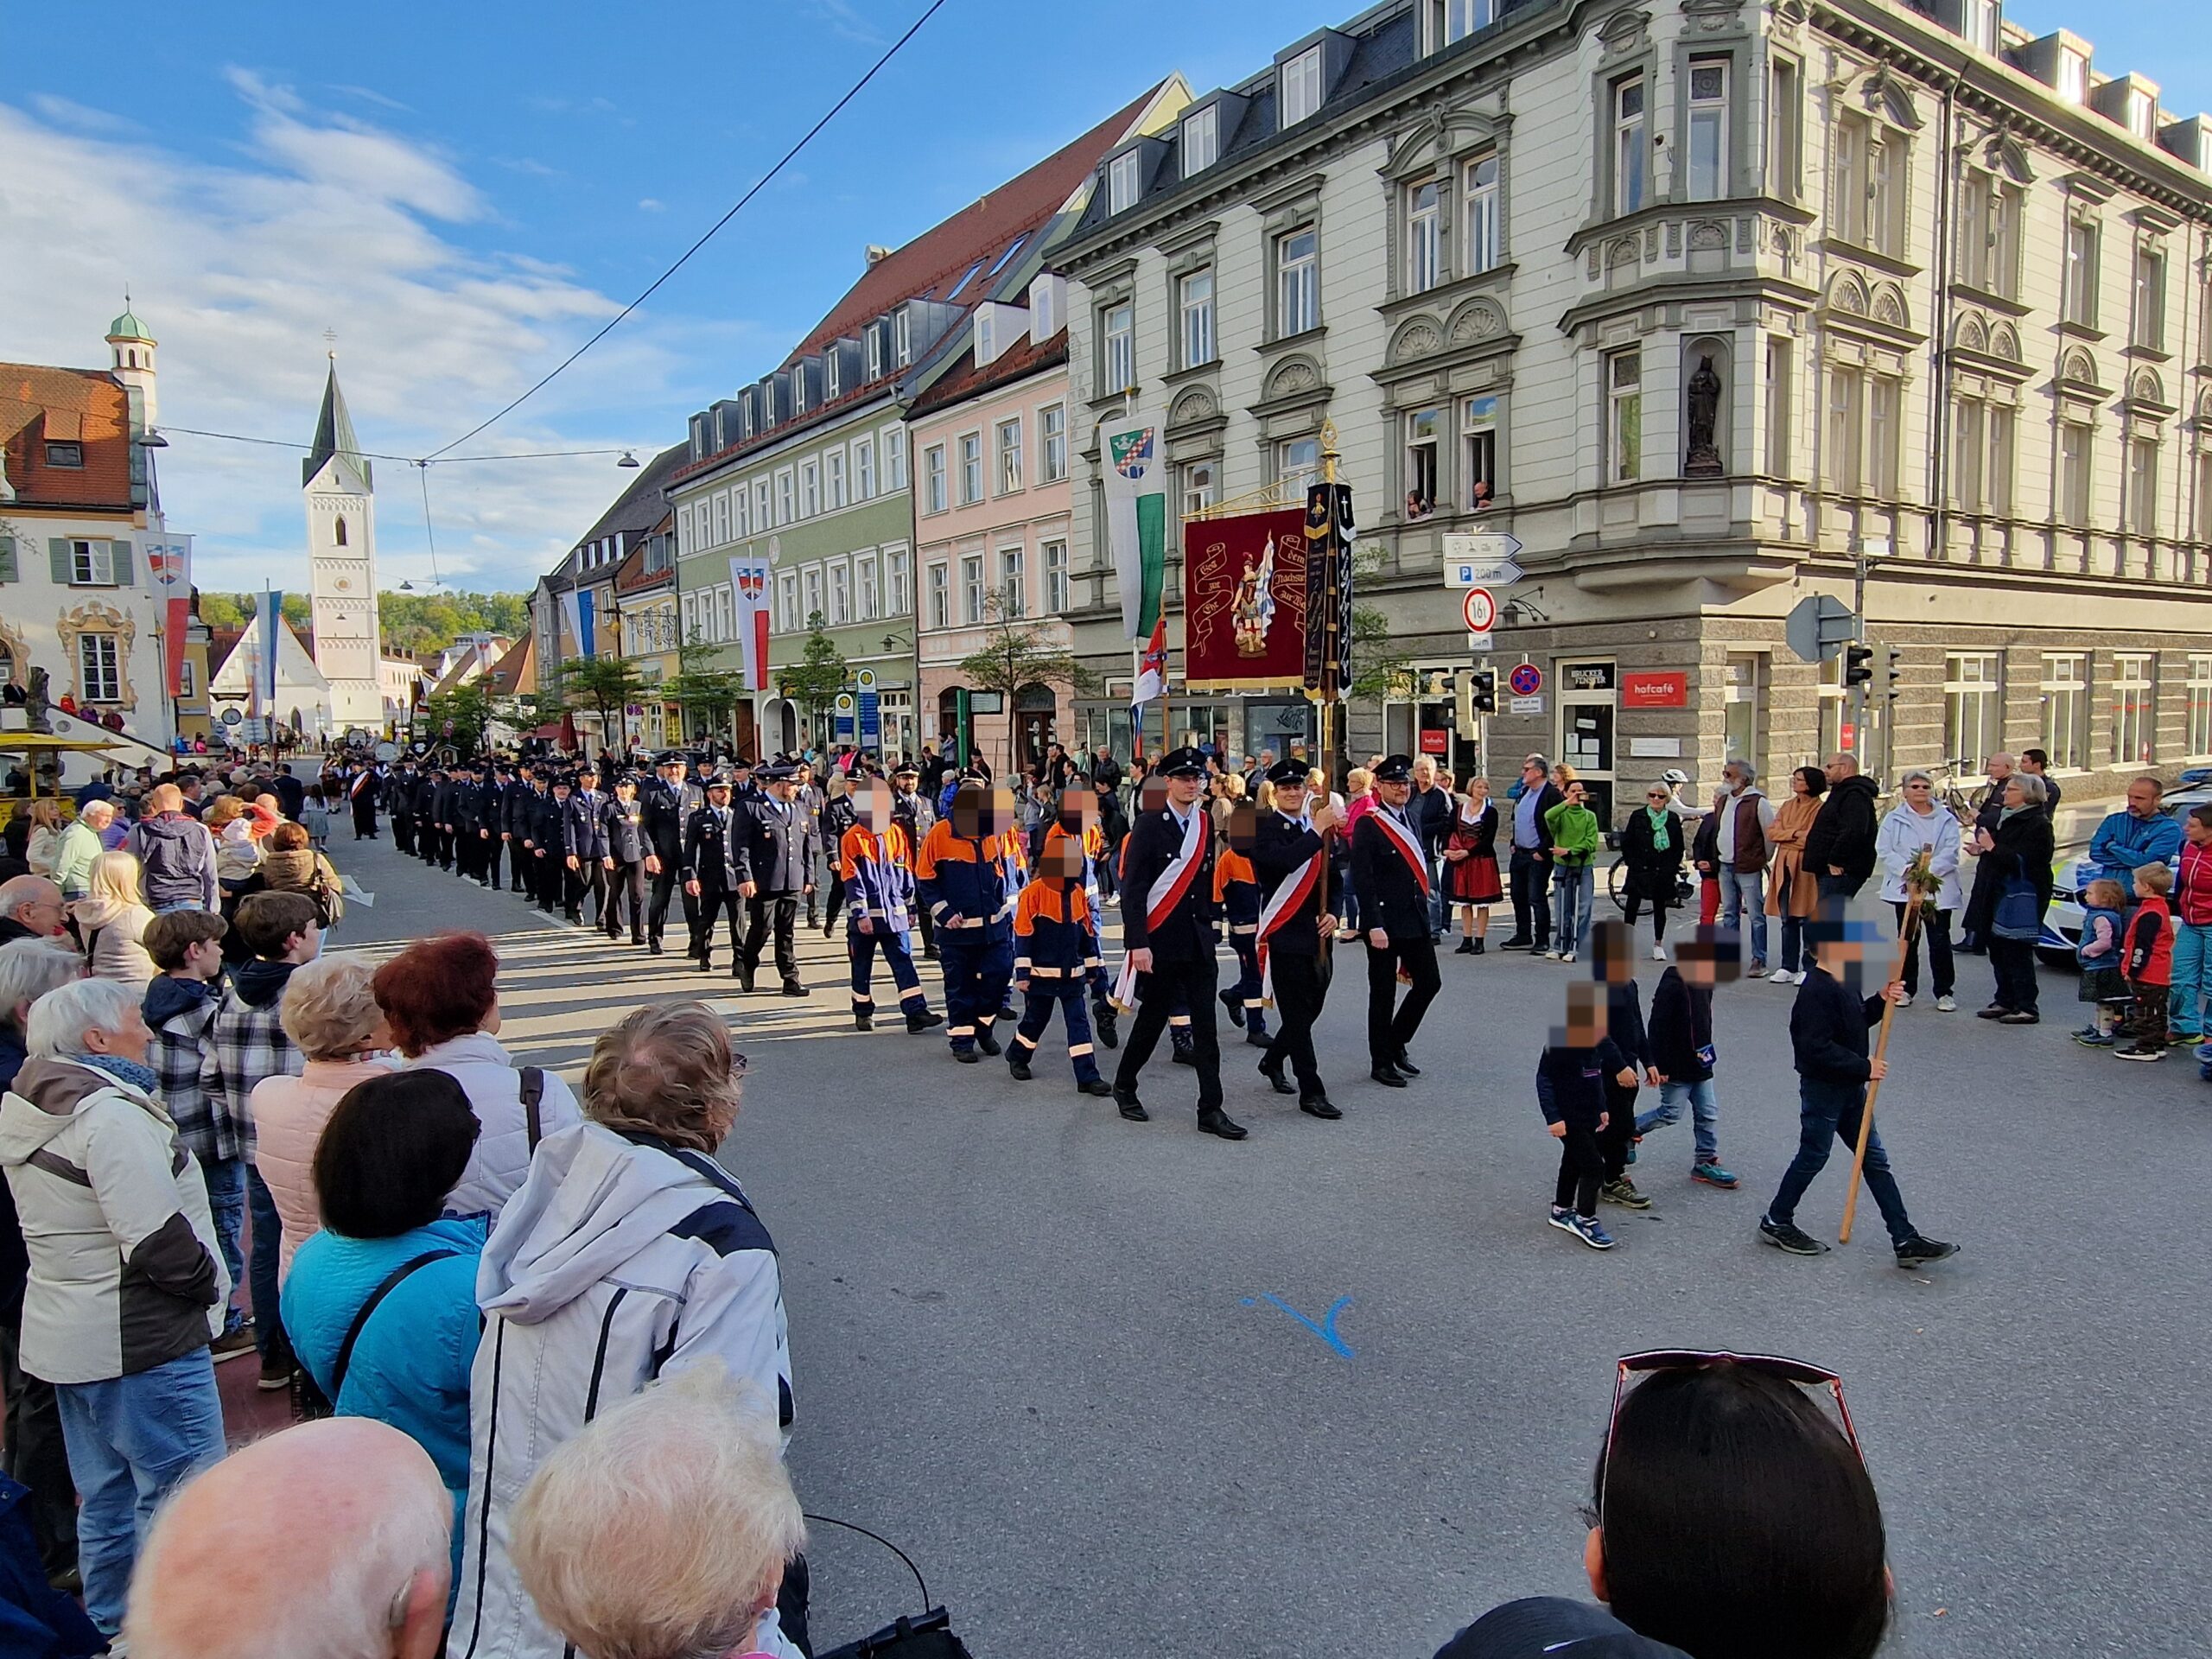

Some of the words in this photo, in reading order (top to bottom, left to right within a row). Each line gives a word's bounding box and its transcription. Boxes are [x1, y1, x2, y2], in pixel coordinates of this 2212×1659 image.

[1475, 568, 1491, 580] 200
[1492, 570, 1502, 580] m
[1634, 683, 1675, 695] hofcafé
